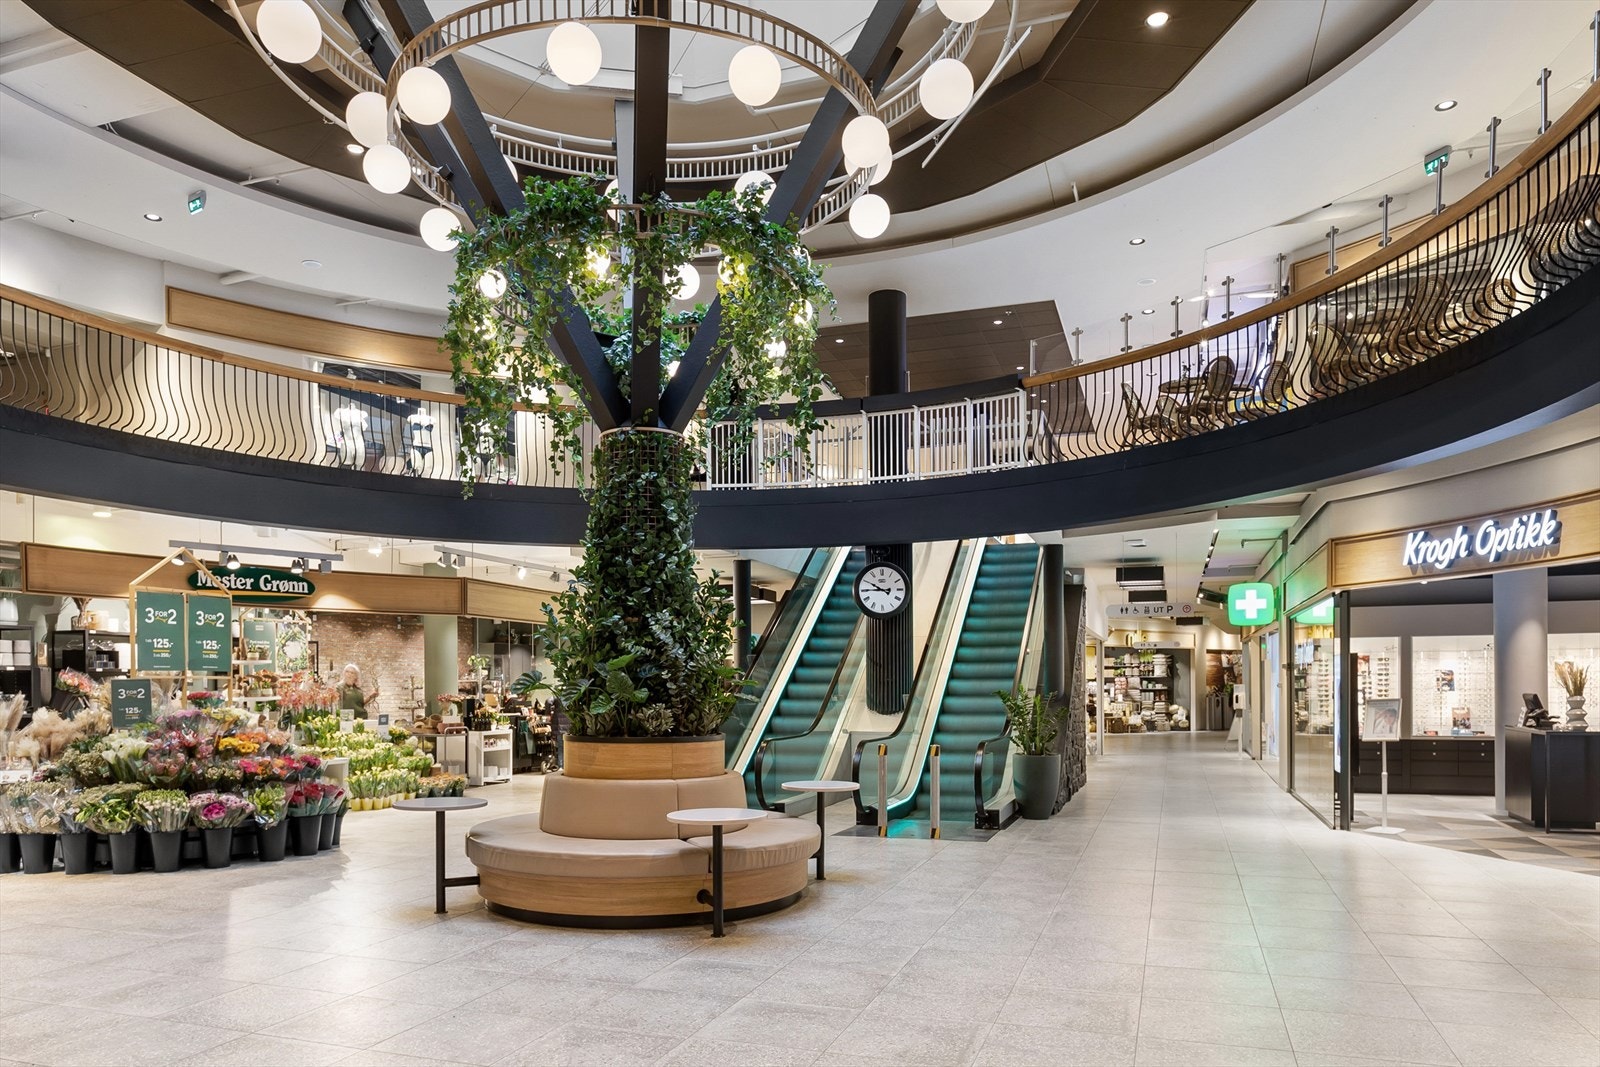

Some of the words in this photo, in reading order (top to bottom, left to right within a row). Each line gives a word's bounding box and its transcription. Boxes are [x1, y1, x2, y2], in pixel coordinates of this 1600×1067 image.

[1402, 525, 1468, 569] Krogh
[1475, 509, 1557, 563] Optikk
[259, 574, 309, 594] Grønn
[144, 607, 155, 623] 3
[167, 608, 177, 625] 2
[195, 610, 204, 626] 3
[216, 612, 225, 628] 2
[1166, 606, 1174, 614] P
[118, 688, 126, 699] 3
[137, 688, 146, 699] 2
